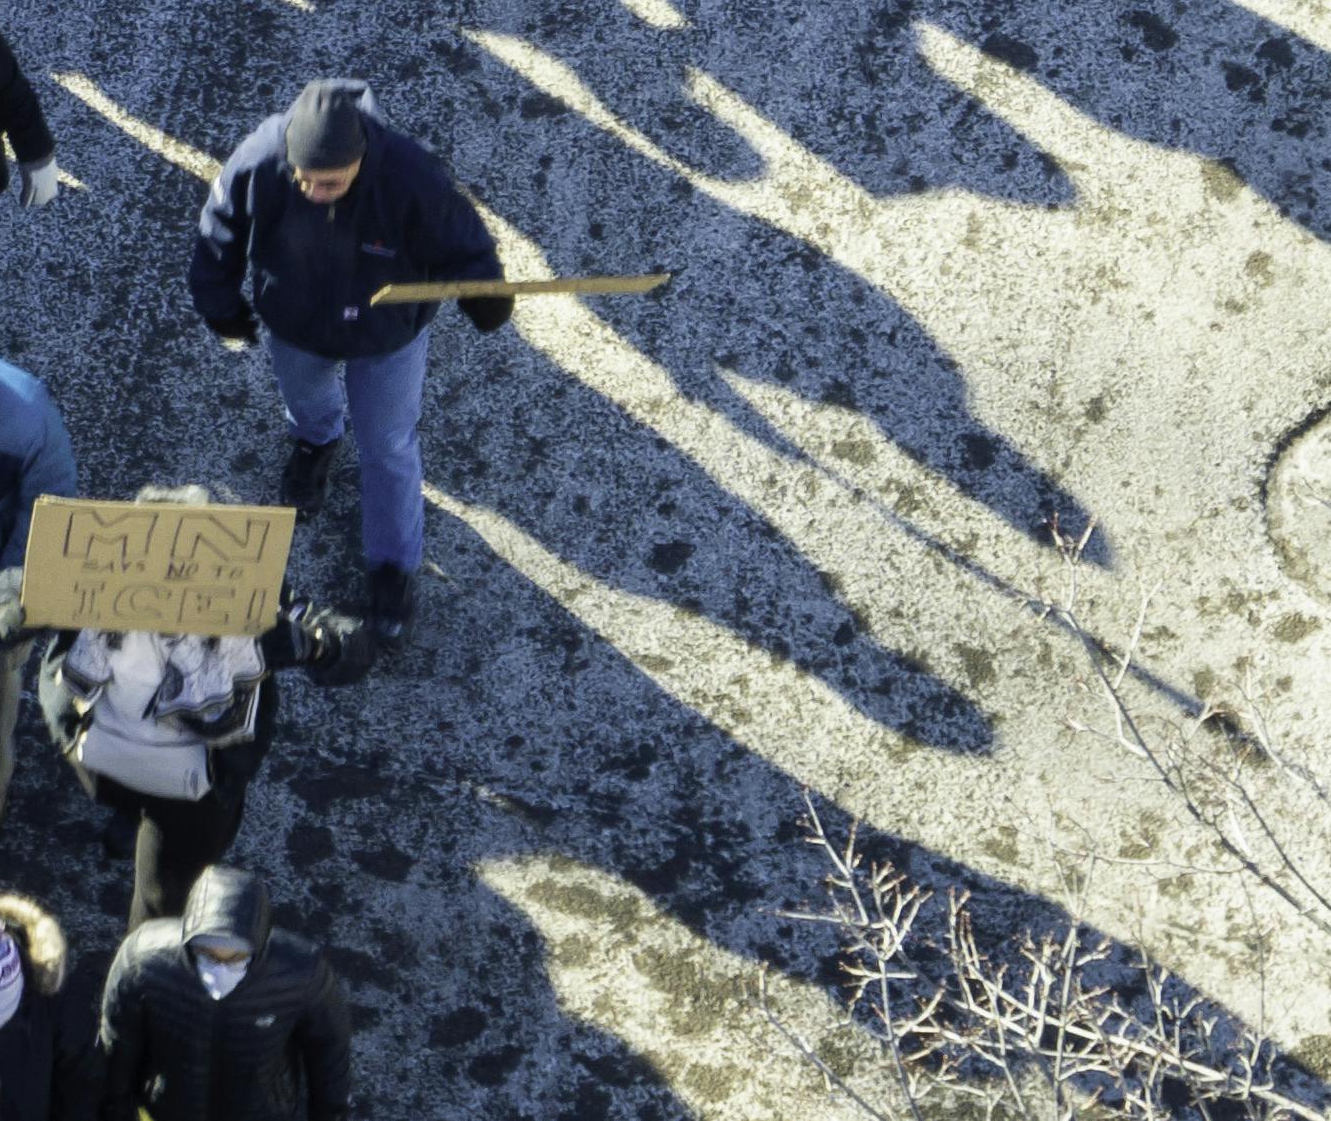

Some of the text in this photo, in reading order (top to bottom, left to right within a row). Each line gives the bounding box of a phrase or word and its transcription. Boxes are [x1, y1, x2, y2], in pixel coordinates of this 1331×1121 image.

[62, 509, 270, 563] MN
[82, 559, 243, 579] SAYS NO TO
[72, 579, 265, 630] ICE!
